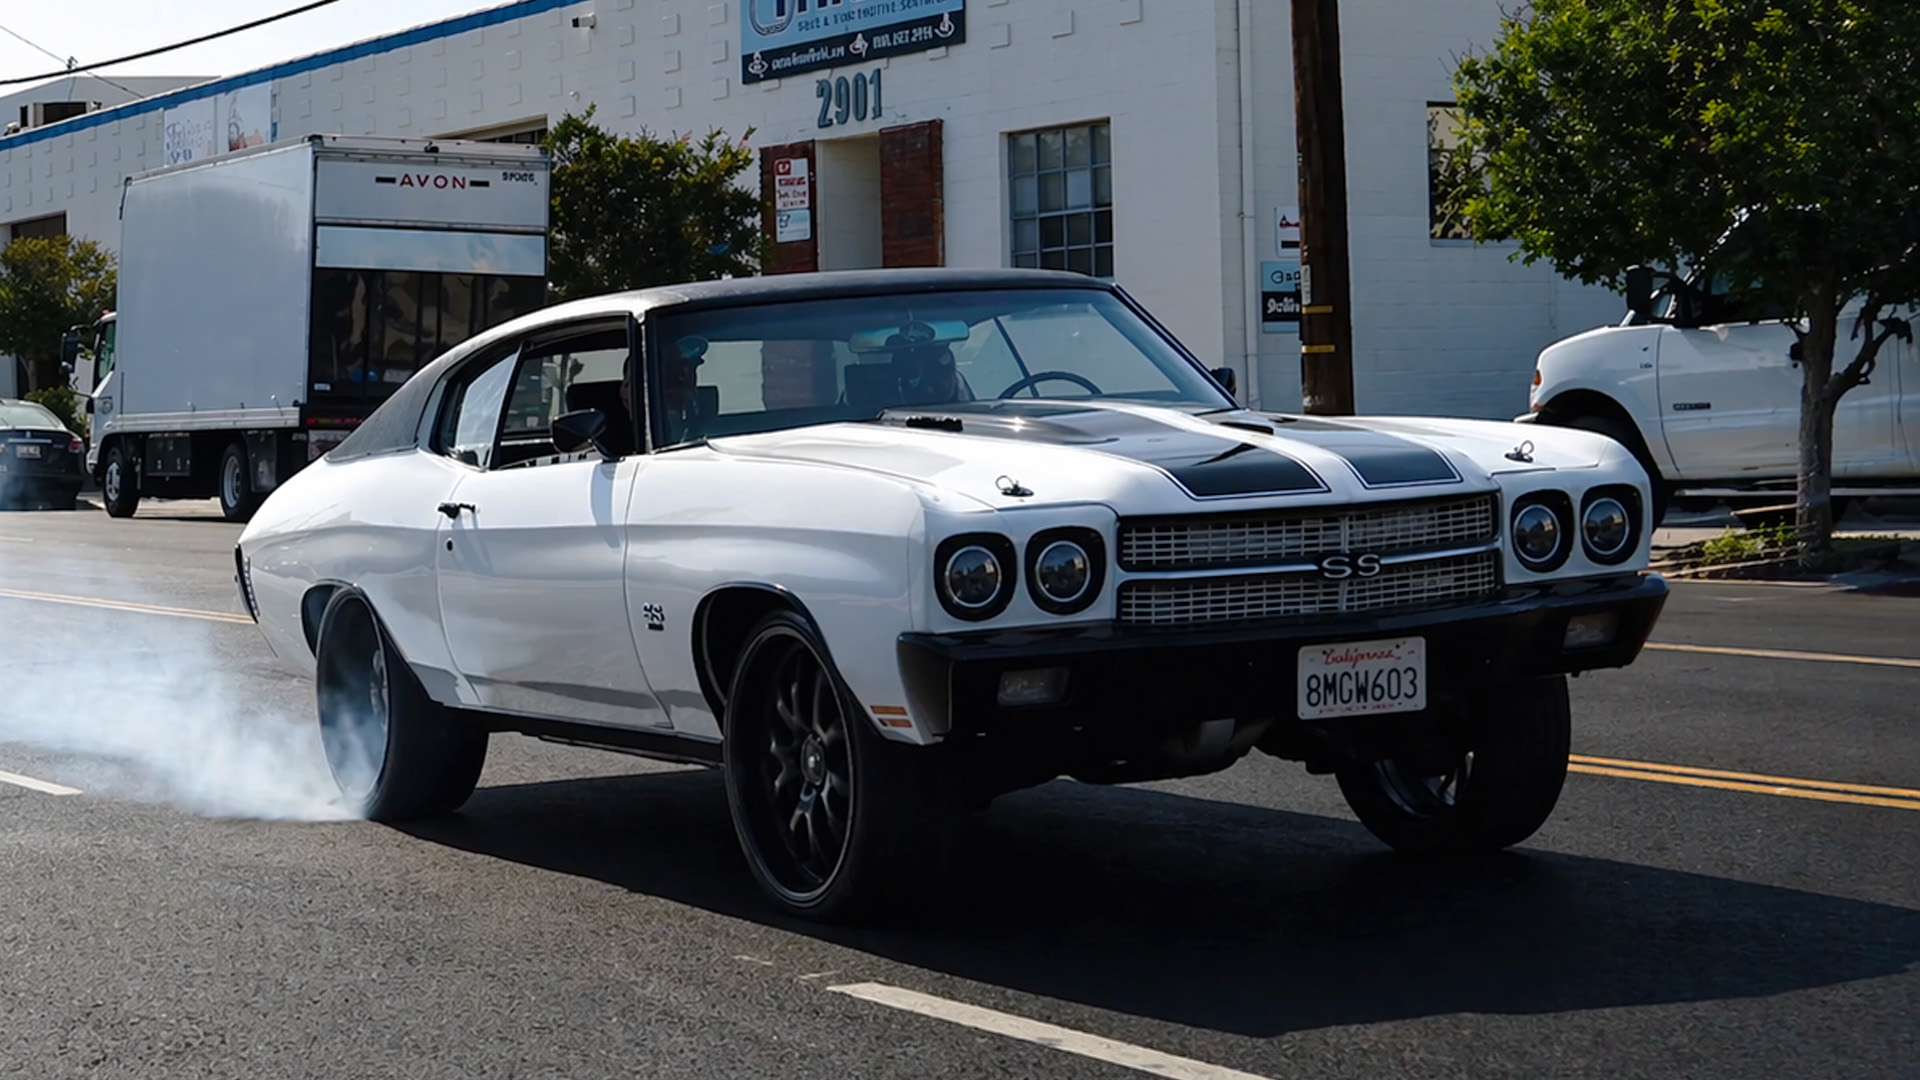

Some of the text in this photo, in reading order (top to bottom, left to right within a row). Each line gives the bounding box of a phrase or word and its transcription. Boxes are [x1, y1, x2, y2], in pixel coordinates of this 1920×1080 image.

[816, 68, 882, 129] 2901
[400, 173, 466, 190] AVON
[1322, 553, 1380, 578] SS
[1306, 667, 1418, 707] 8MGW603
